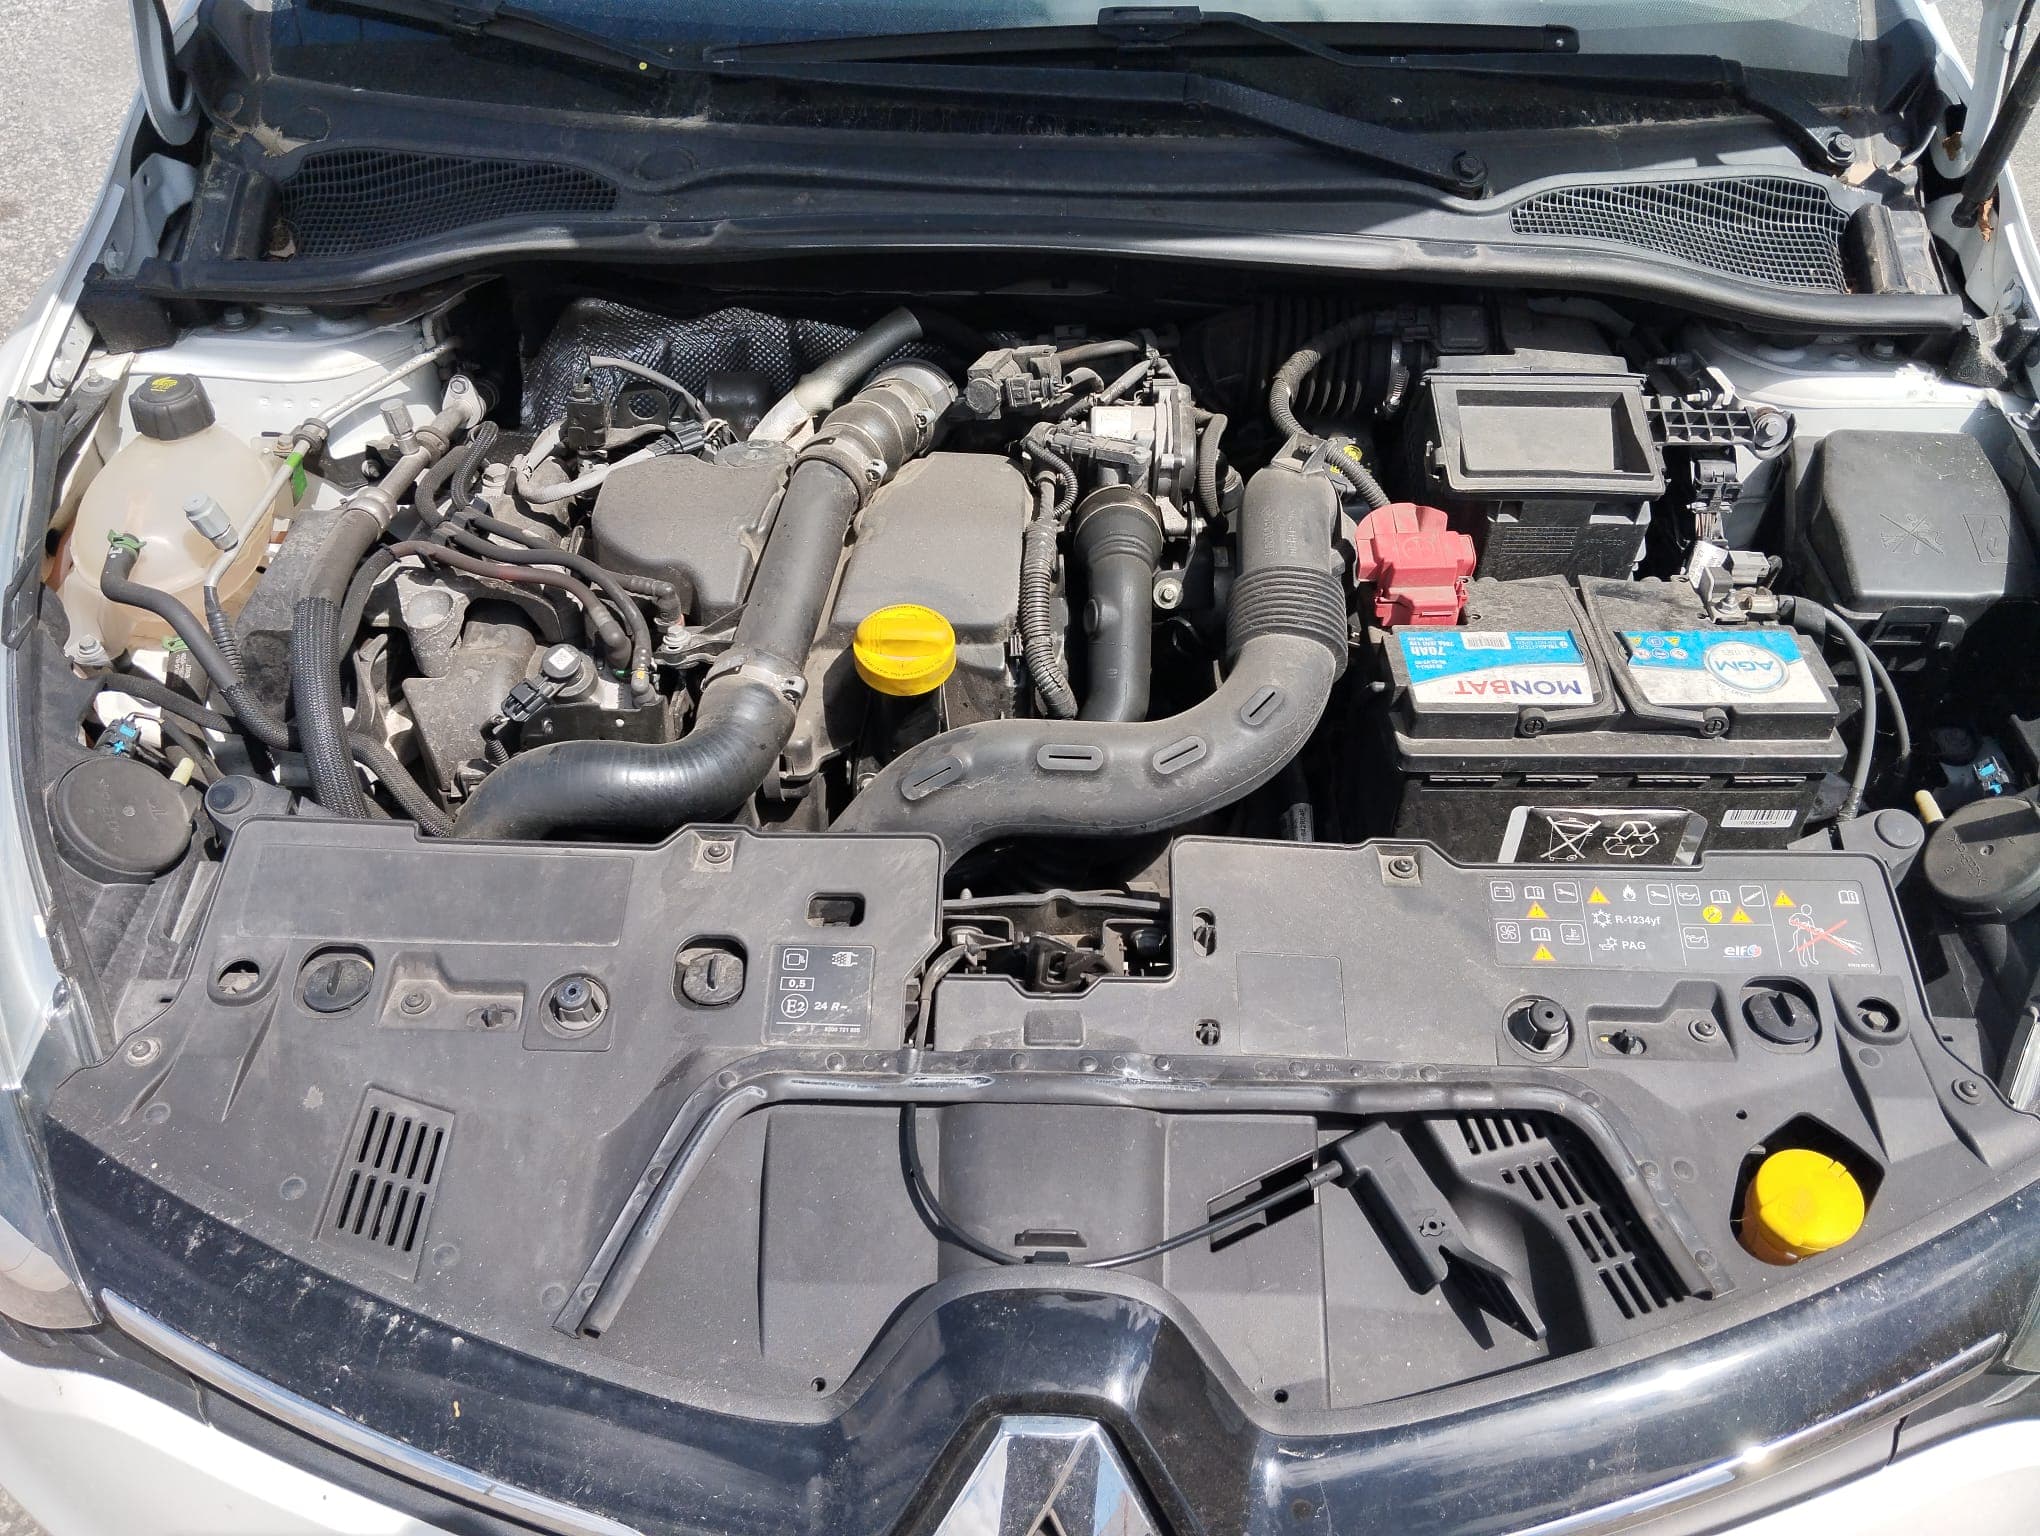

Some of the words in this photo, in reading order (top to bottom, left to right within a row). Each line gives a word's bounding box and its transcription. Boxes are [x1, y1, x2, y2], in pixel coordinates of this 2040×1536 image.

[1410, 646, 1447, 657] 70Ah
[1714, 661, 1774, 671] AGM
[1454, 679, 1582, 695] MONBAT
[1614, 915, 1661, 927] R-1234yf
[1622, 940, 1647, 950] PAG
[1724, 944, 1748, 956] elf
[788, 979, 806, 989] 0,5
[786, 999, 806, 1014] E2
[814, 1002, 828, 1011] 24
